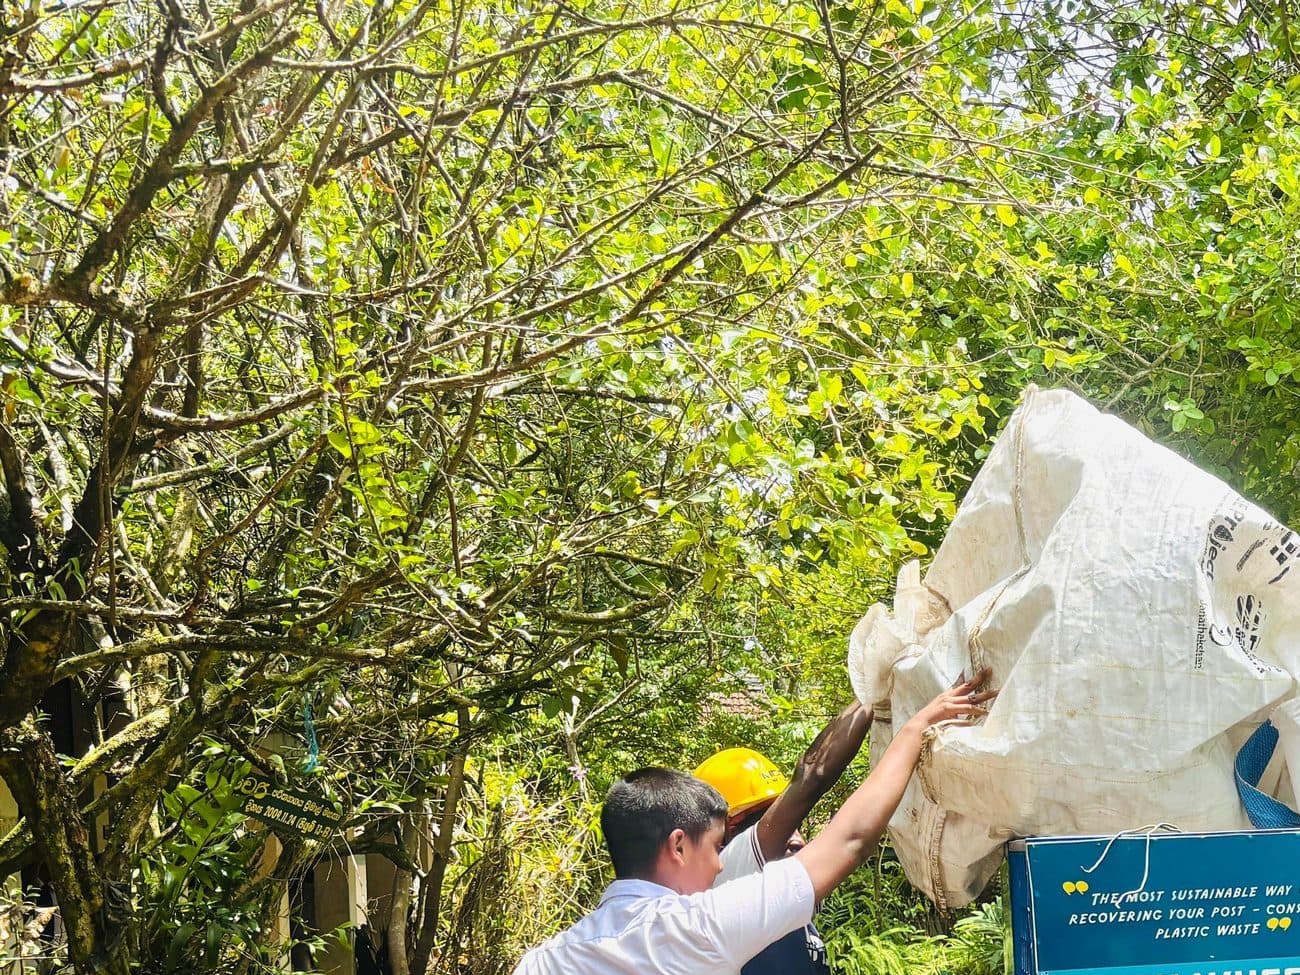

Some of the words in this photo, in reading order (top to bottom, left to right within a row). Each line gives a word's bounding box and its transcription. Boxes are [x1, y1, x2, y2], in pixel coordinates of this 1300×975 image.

[1091, 892, 1121, 906] THE
[1126, 891, 1164, 903] MOST
[1171, 886, 1258, 901] SUSTAINABLE
[1265, 885, 1293, 897] WAY
[1069, 911, 1163, 925] RECOVERING
[1168, 907, 1204, 920] YOUR
[1211, 905, 1246, 918] POST
[1155, 926, 1210, 939] PLASTIC
[1216, 923, 1260, 936] WASTE
